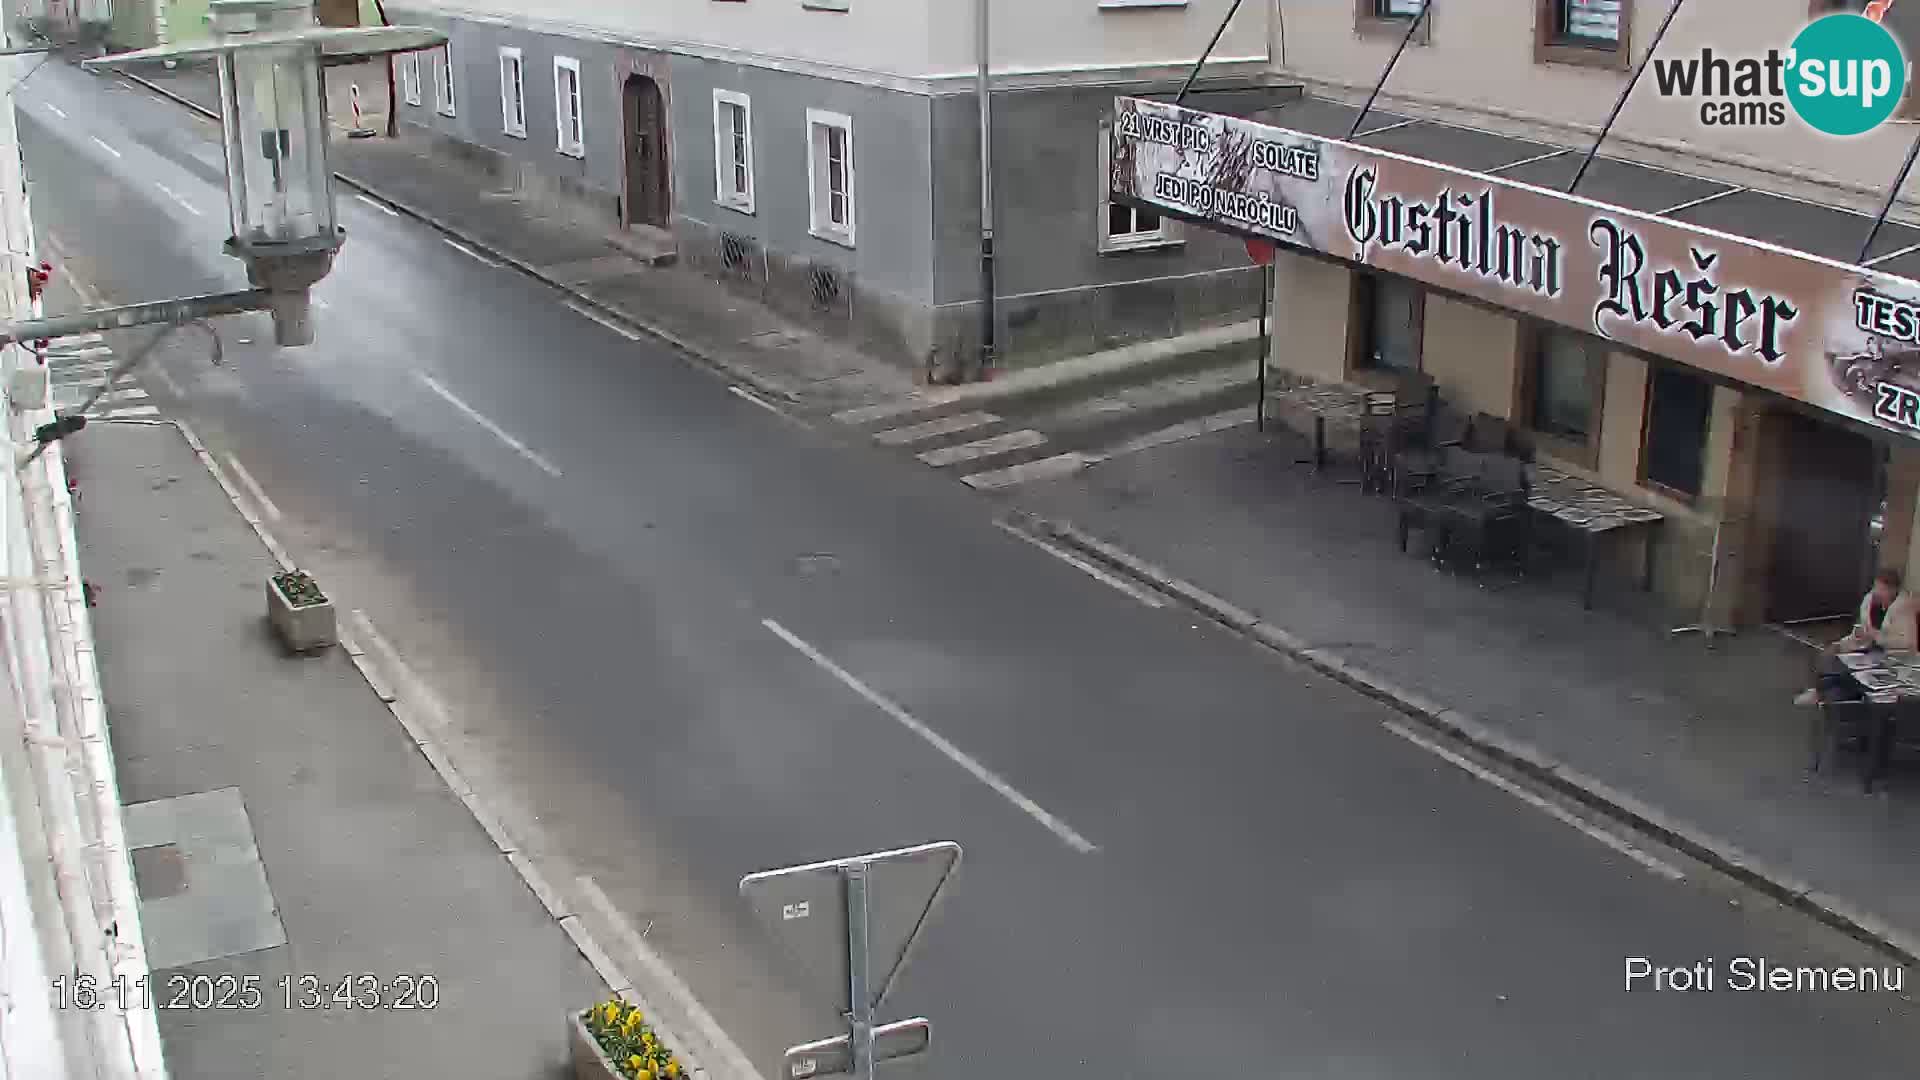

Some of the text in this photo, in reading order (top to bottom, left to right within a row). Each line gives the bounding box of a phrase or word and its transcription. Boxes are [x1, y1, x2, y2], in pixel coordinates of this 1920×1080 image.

[1121, 111, 1140, 136] 21
[1143, 116, 1182, 146] VRST
[1253, 141, 1318, 180] SOLATE
[1156, 173, 1296, 234] JEDI PO NAROČILU
[1344, 163, 1798, 362] Gostilna Rešer
